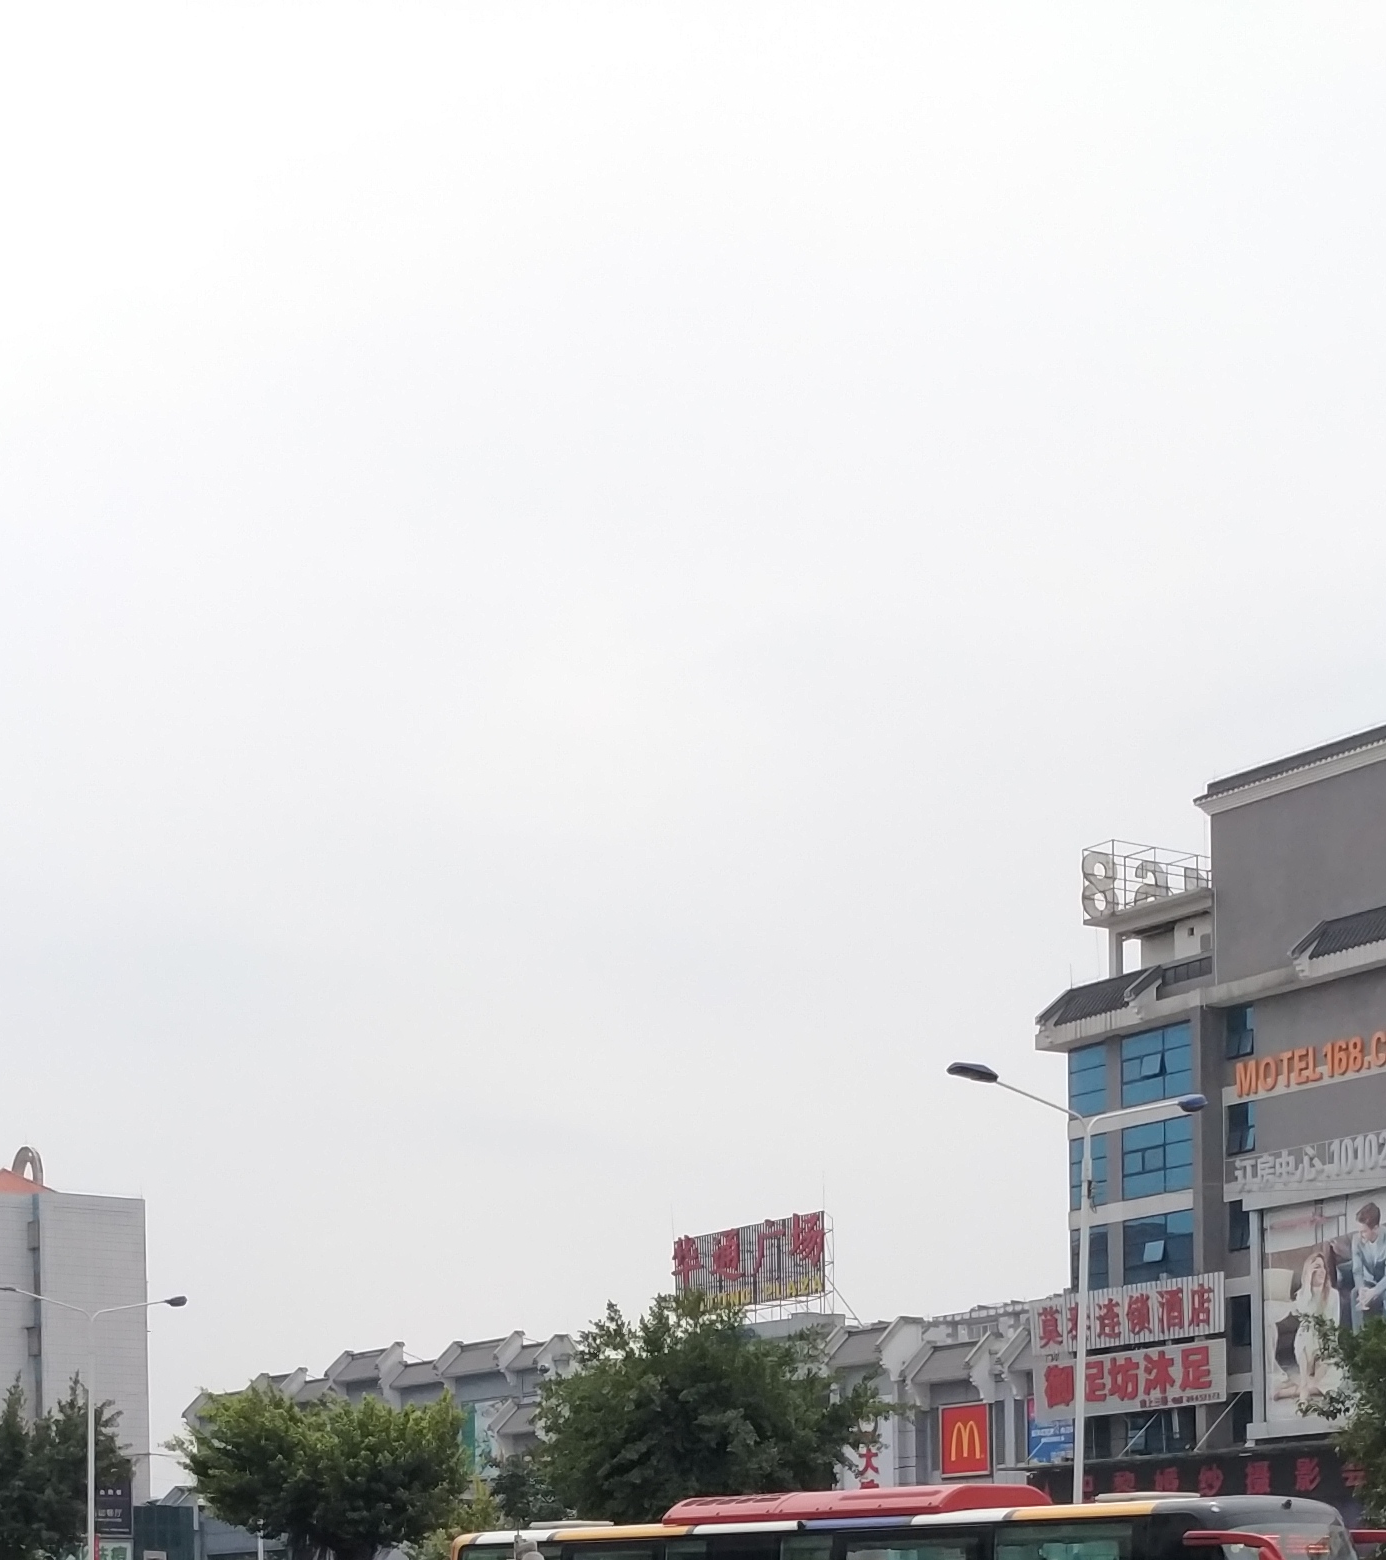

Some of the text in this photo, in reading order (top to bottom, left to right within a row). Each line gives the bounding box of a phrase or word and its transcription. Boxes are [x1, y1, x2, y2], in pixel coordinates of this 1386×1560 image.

[671, 1213, 826, 1288] 华通广场
[764, 1276, 823, 1300] PLAZA
